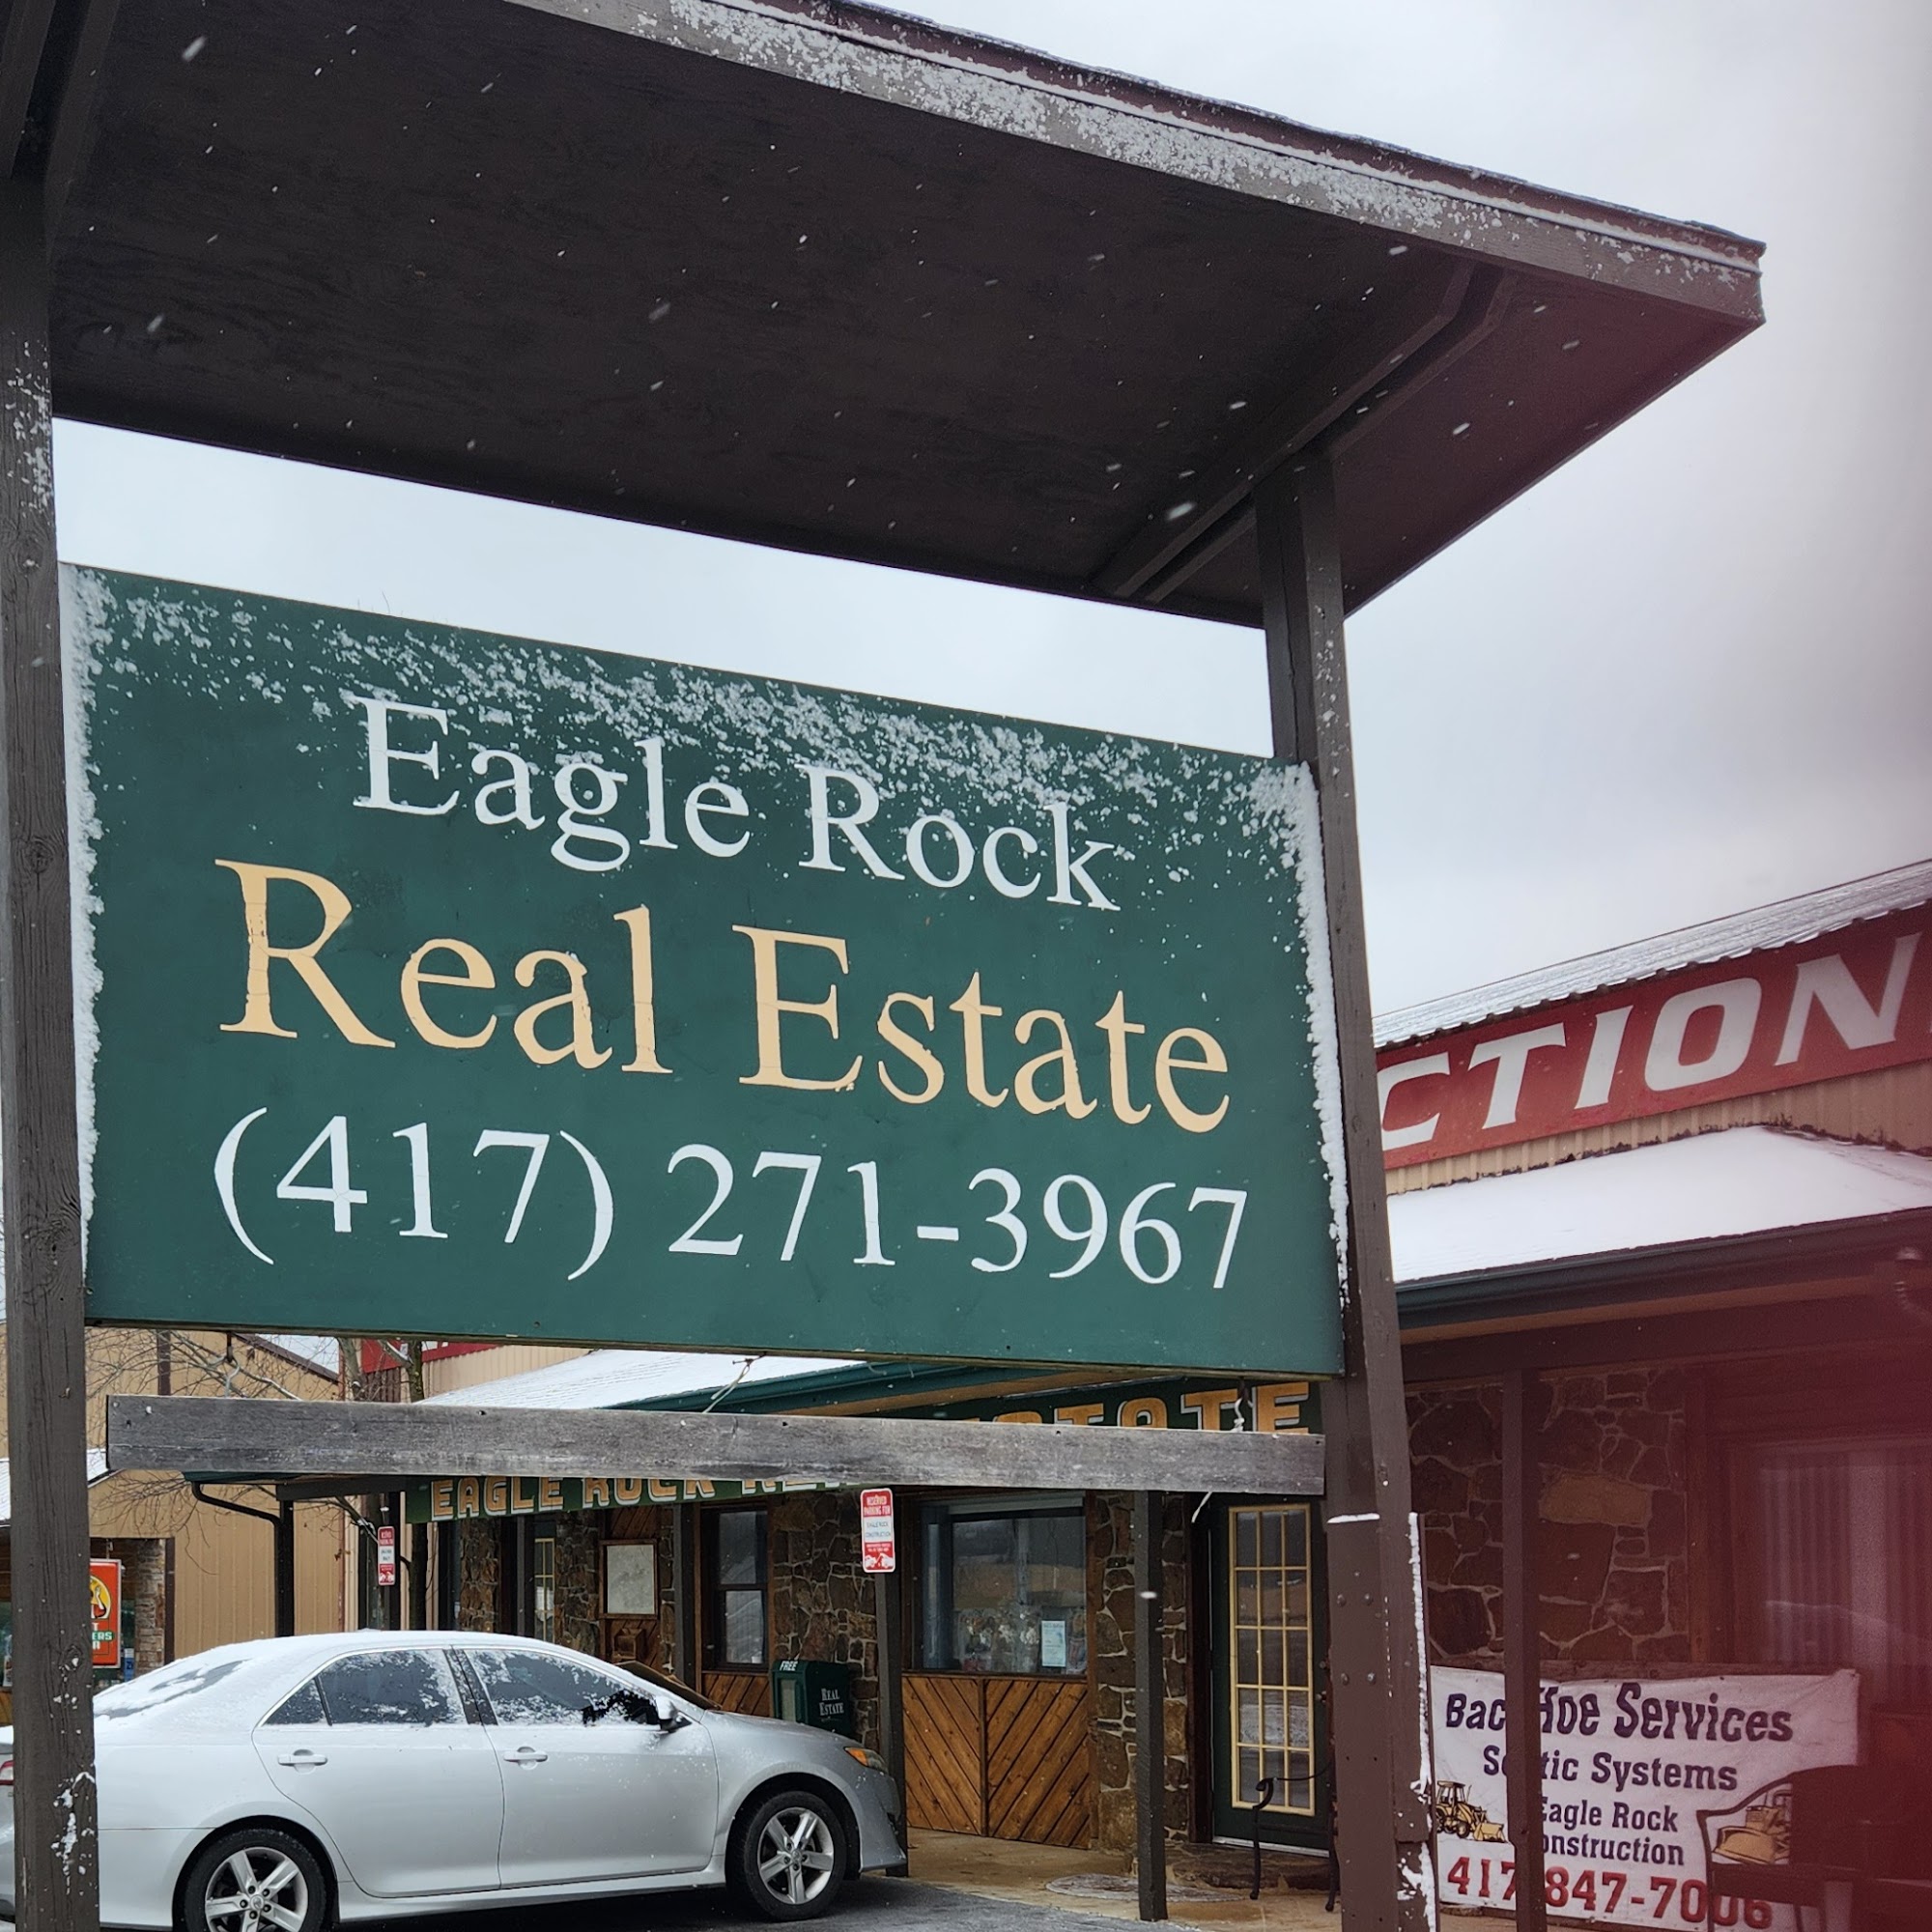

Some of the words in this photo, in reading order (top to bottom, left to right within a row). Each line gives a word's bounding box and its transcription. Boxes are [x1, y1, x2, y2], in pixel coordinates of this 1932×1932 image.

[354, 695, 751, 871] Eagle
[796, 762, 1122, 911] Rock
[214, 859, 673, 1073] Real
[732, 924, 1230, 1132] Estate
[213, 1106, 613, 1281] (417)
[668, 1144, 1247, 1289] 271-3967
[431, 1476, 564, 1520] EAGLE
[779, 1661, 798, 1671] FREE
[818, 1702, 844, 1717] ESTATE
[820, 1688, 840, 1701] REAL
[1446, 1693, 1506, 1731] Bac
[1614, 1682, 1793, 1742] Services
[1483, 1745, 1579, 1781] Stic
[1591, 1751, 1738, 1792] Systems
[1611, 1802, 1679, 1833] Rock
[1543, 1833, 1685, 1866] nstruction
